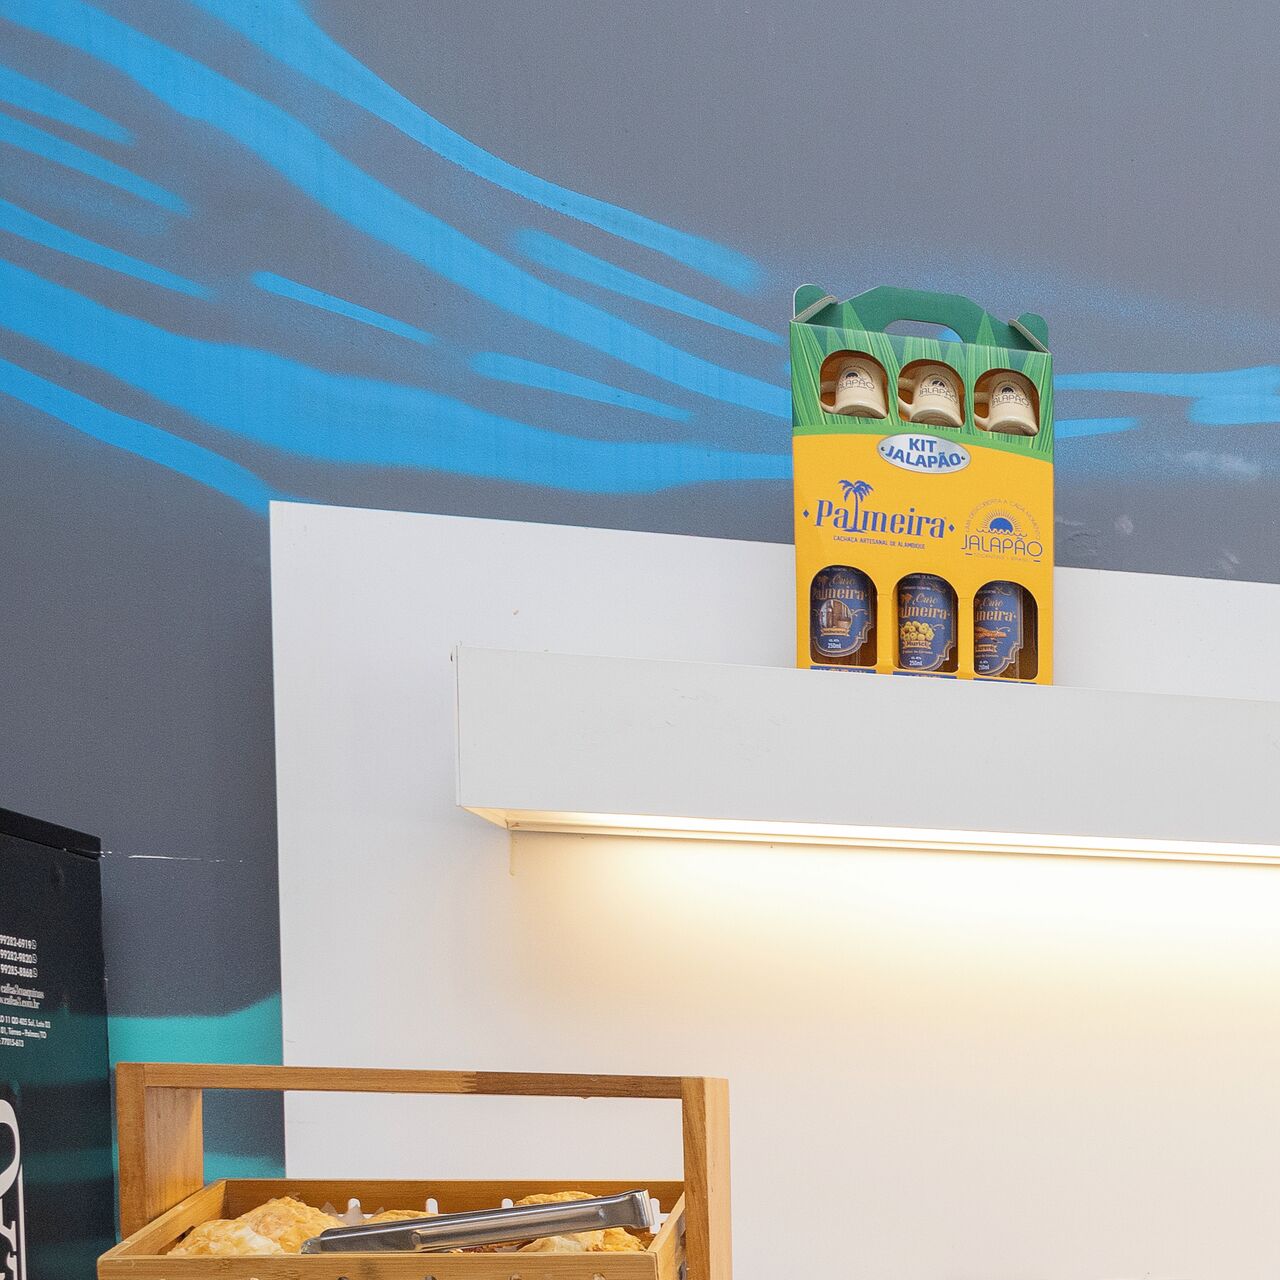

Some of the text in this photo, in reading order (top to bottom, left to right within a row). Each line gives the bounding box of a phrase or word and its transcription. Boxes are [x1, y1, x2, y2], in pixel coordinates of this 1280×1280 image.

[885, 445, 962, 468] JALAPÃO
[909, 438, 937, 453] KIT
[814, 488, 946, 538] Palmeira
[960, 534, 1043, 557] JALAPÃO
